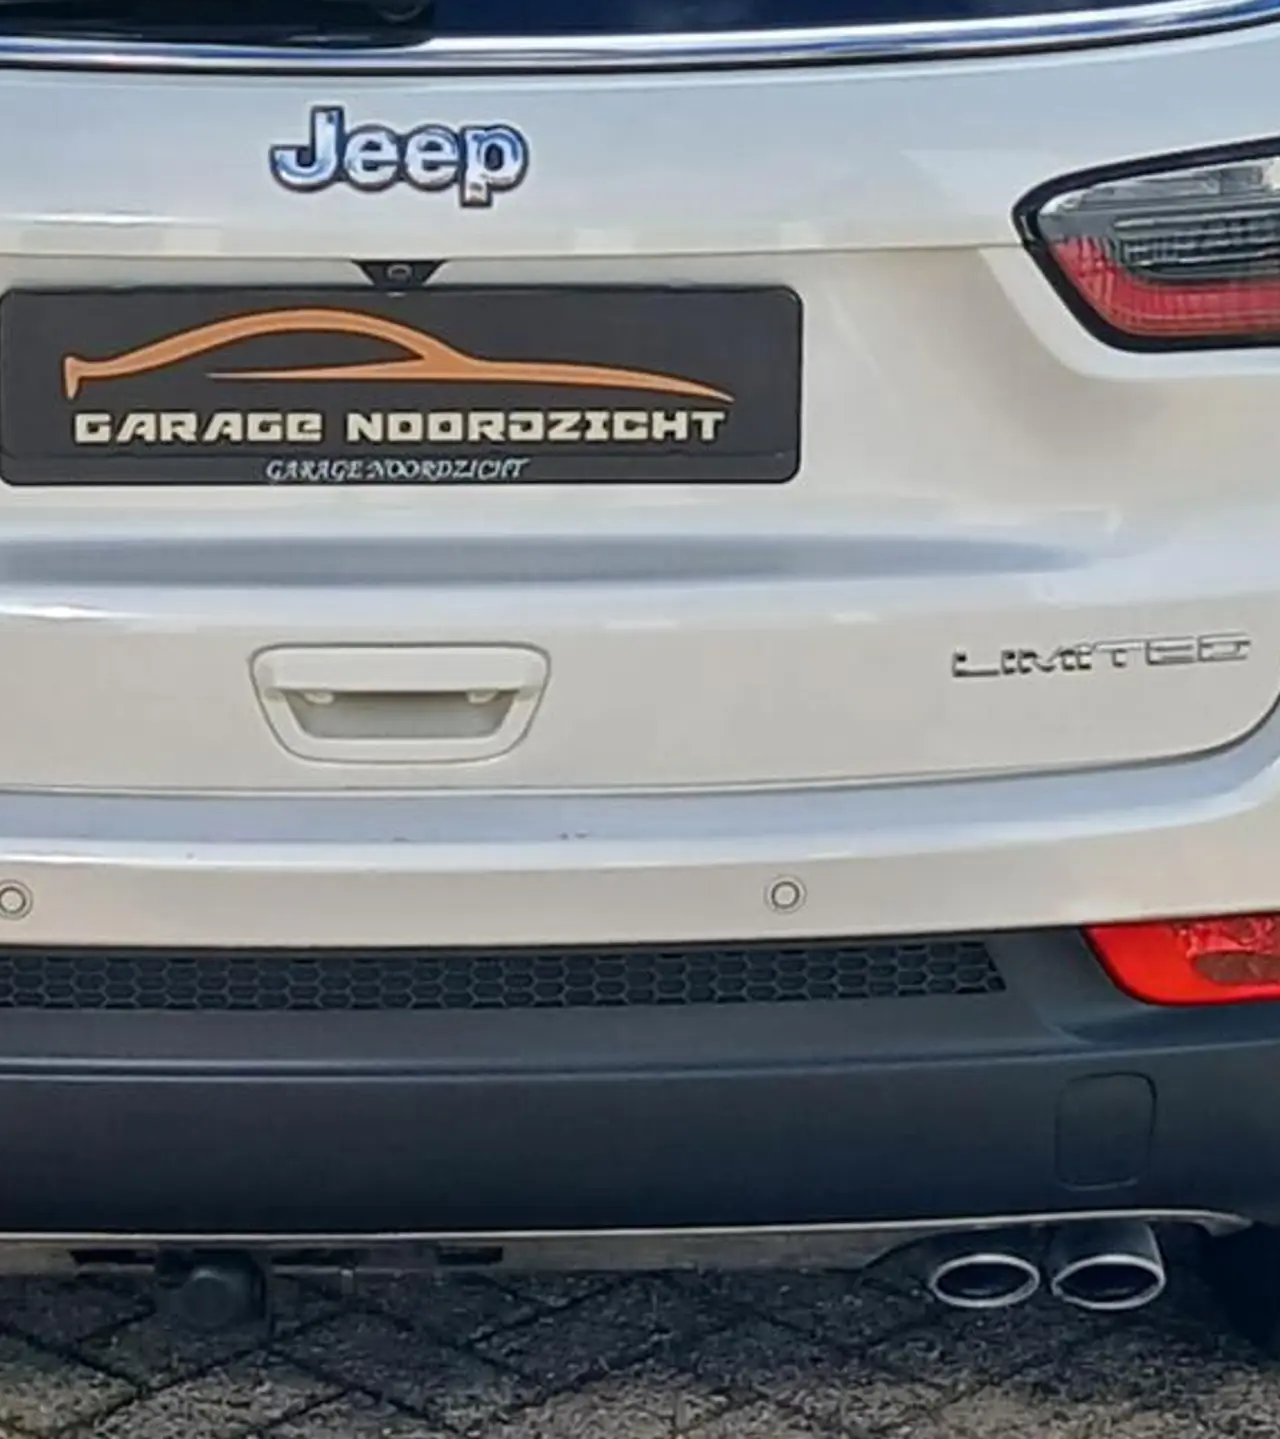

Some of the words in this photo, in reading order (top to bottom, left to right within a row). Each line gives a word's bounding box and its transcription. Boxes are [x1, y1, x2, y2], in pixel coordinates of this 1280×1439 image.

[269, 105, 531, 207] Jeep
[73, 411, 323, 443] GARAGE
[346, 410, 727, 442] NOORDZICHT
[265, 459, 362, 484] GARAGE
[364, 458, 529, 482] NOORDZICHT
[950, 631, 1253, 679] LIMITED
